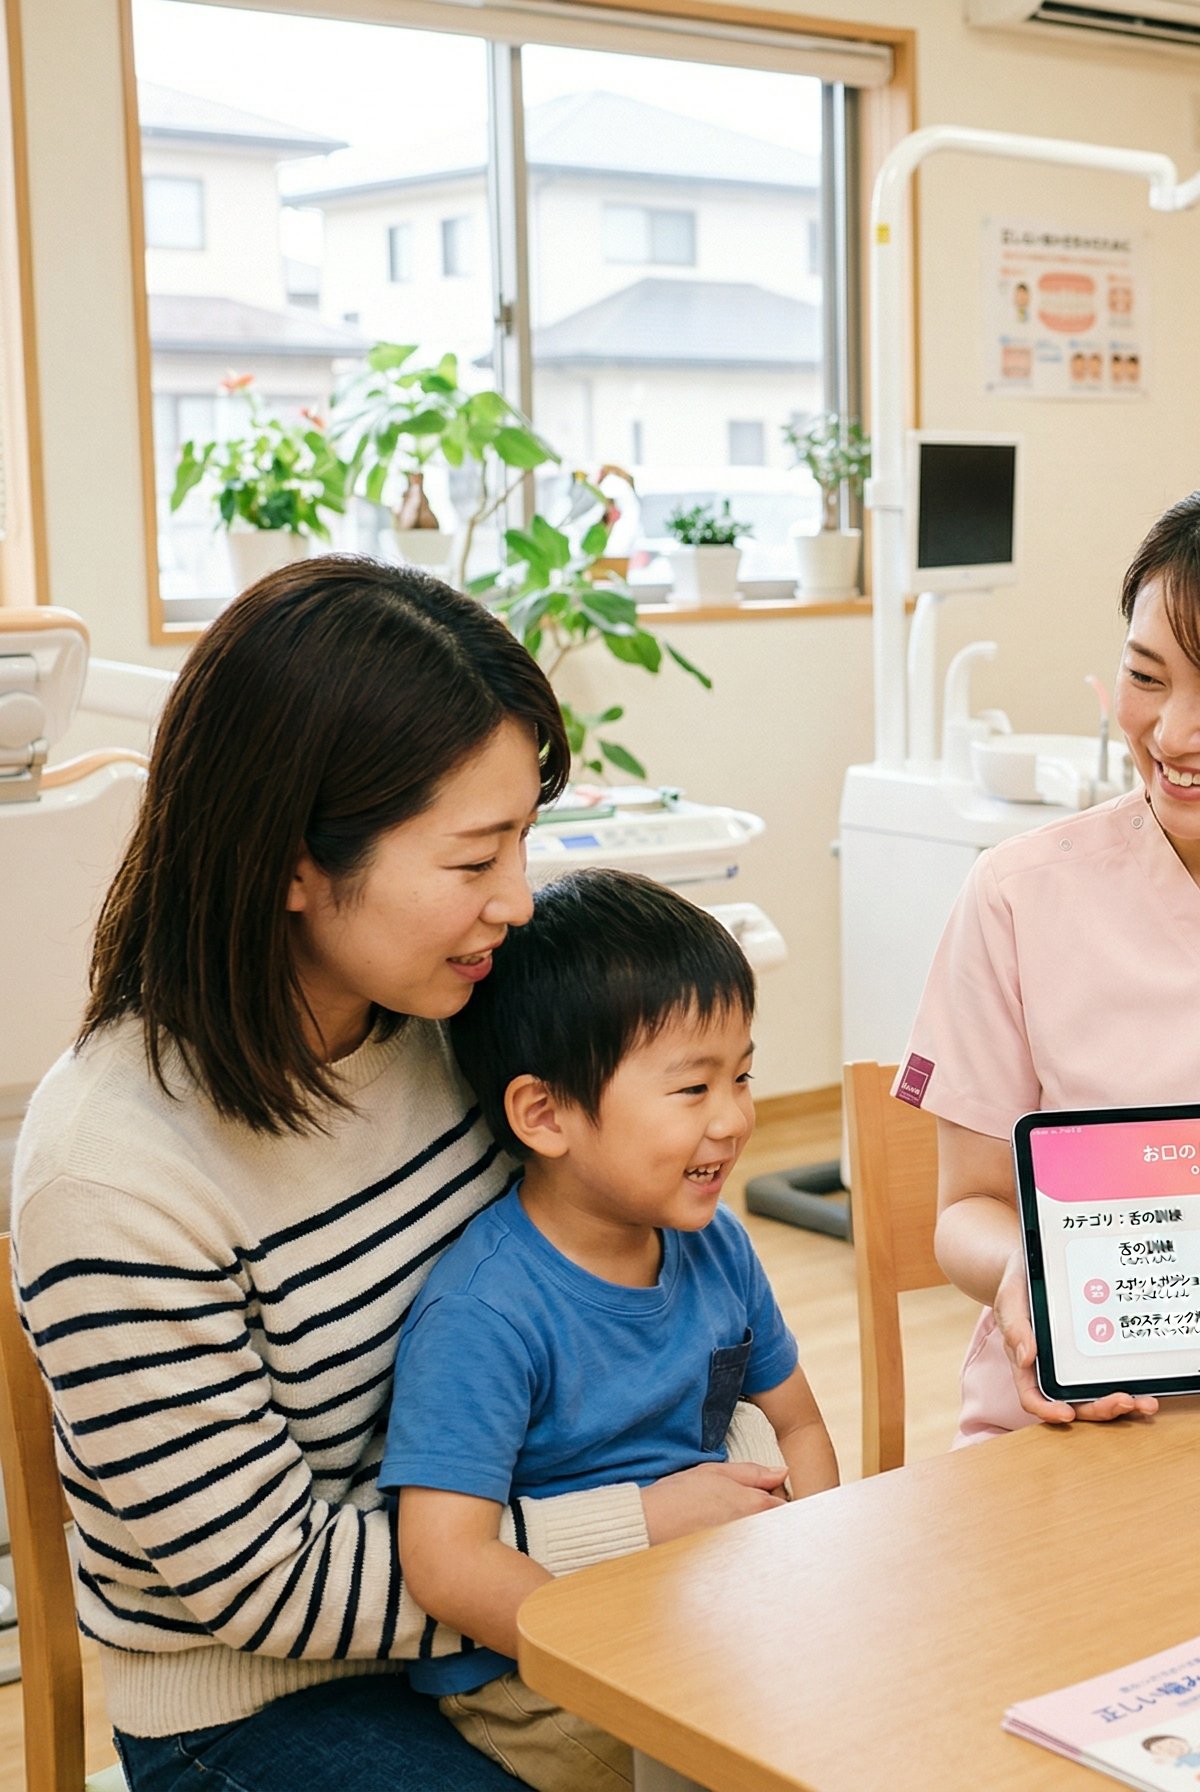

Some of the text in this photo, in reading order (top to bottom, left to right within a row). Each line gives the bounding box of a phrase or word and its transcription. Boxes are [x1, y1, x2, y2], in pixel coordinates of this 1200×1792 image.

[1063, 1209, 1184, 1229] カテゴリ：舌の
